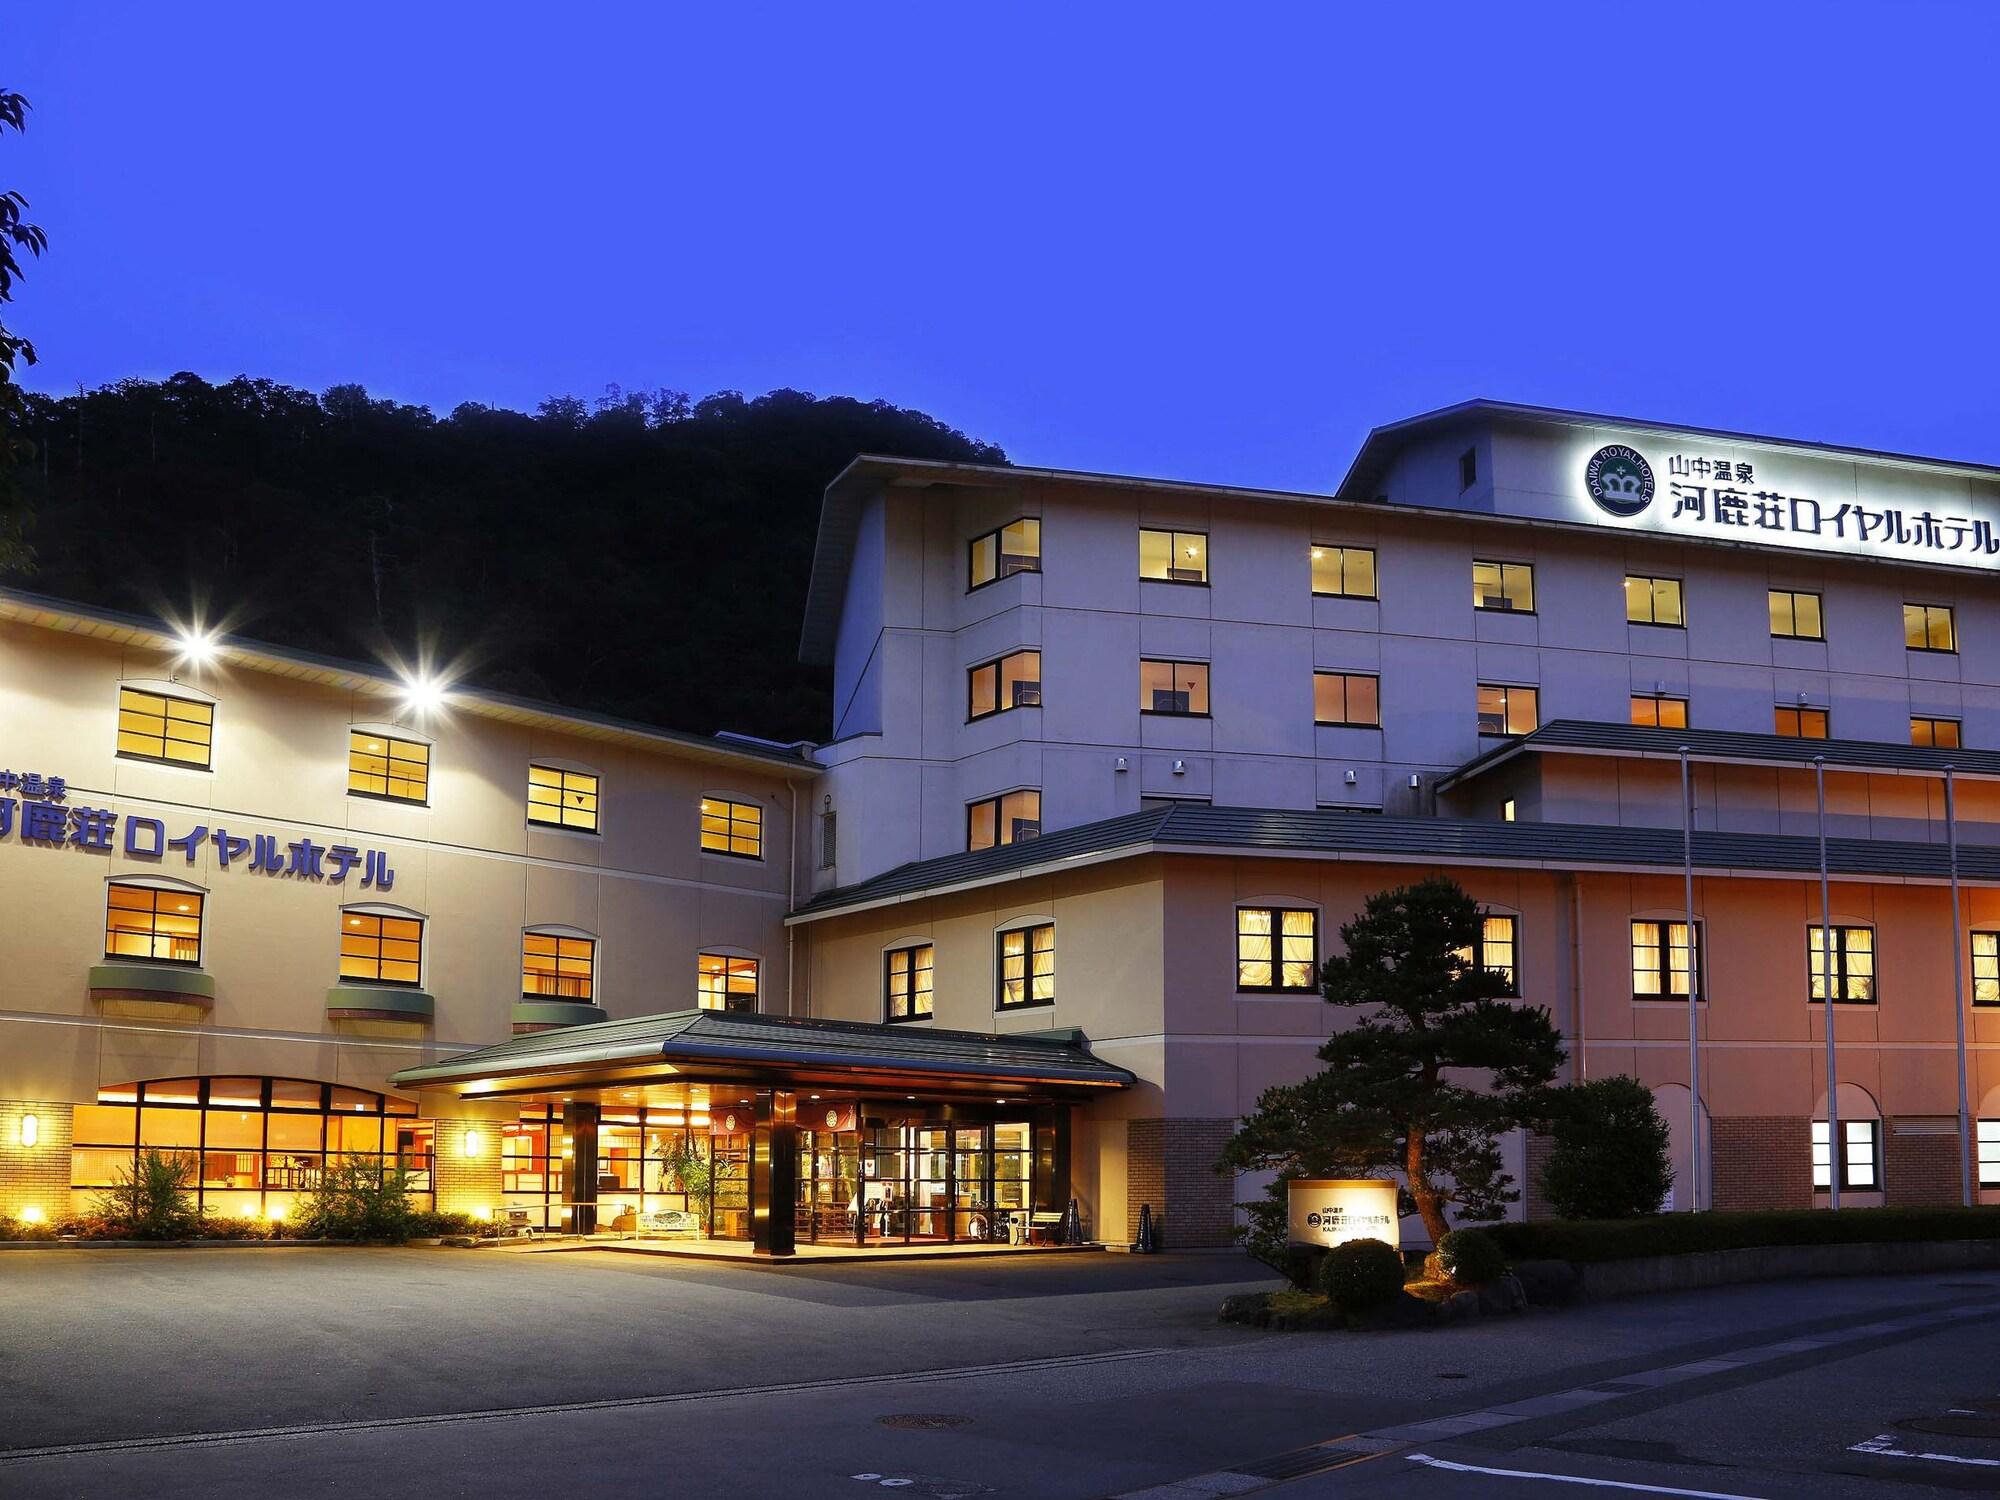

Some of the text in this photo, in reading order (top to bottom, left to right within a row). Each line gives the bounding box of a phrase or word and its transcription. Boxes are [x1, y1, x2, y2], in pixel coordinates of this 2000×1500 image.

[1589, 447, 1654, 504] DAIWA ROYAL HOTELS
[1669, 454, 1755, 484] 山中温泉
[1670, 482, 2000, 555] 河鹿荘ロイヤルホテル
